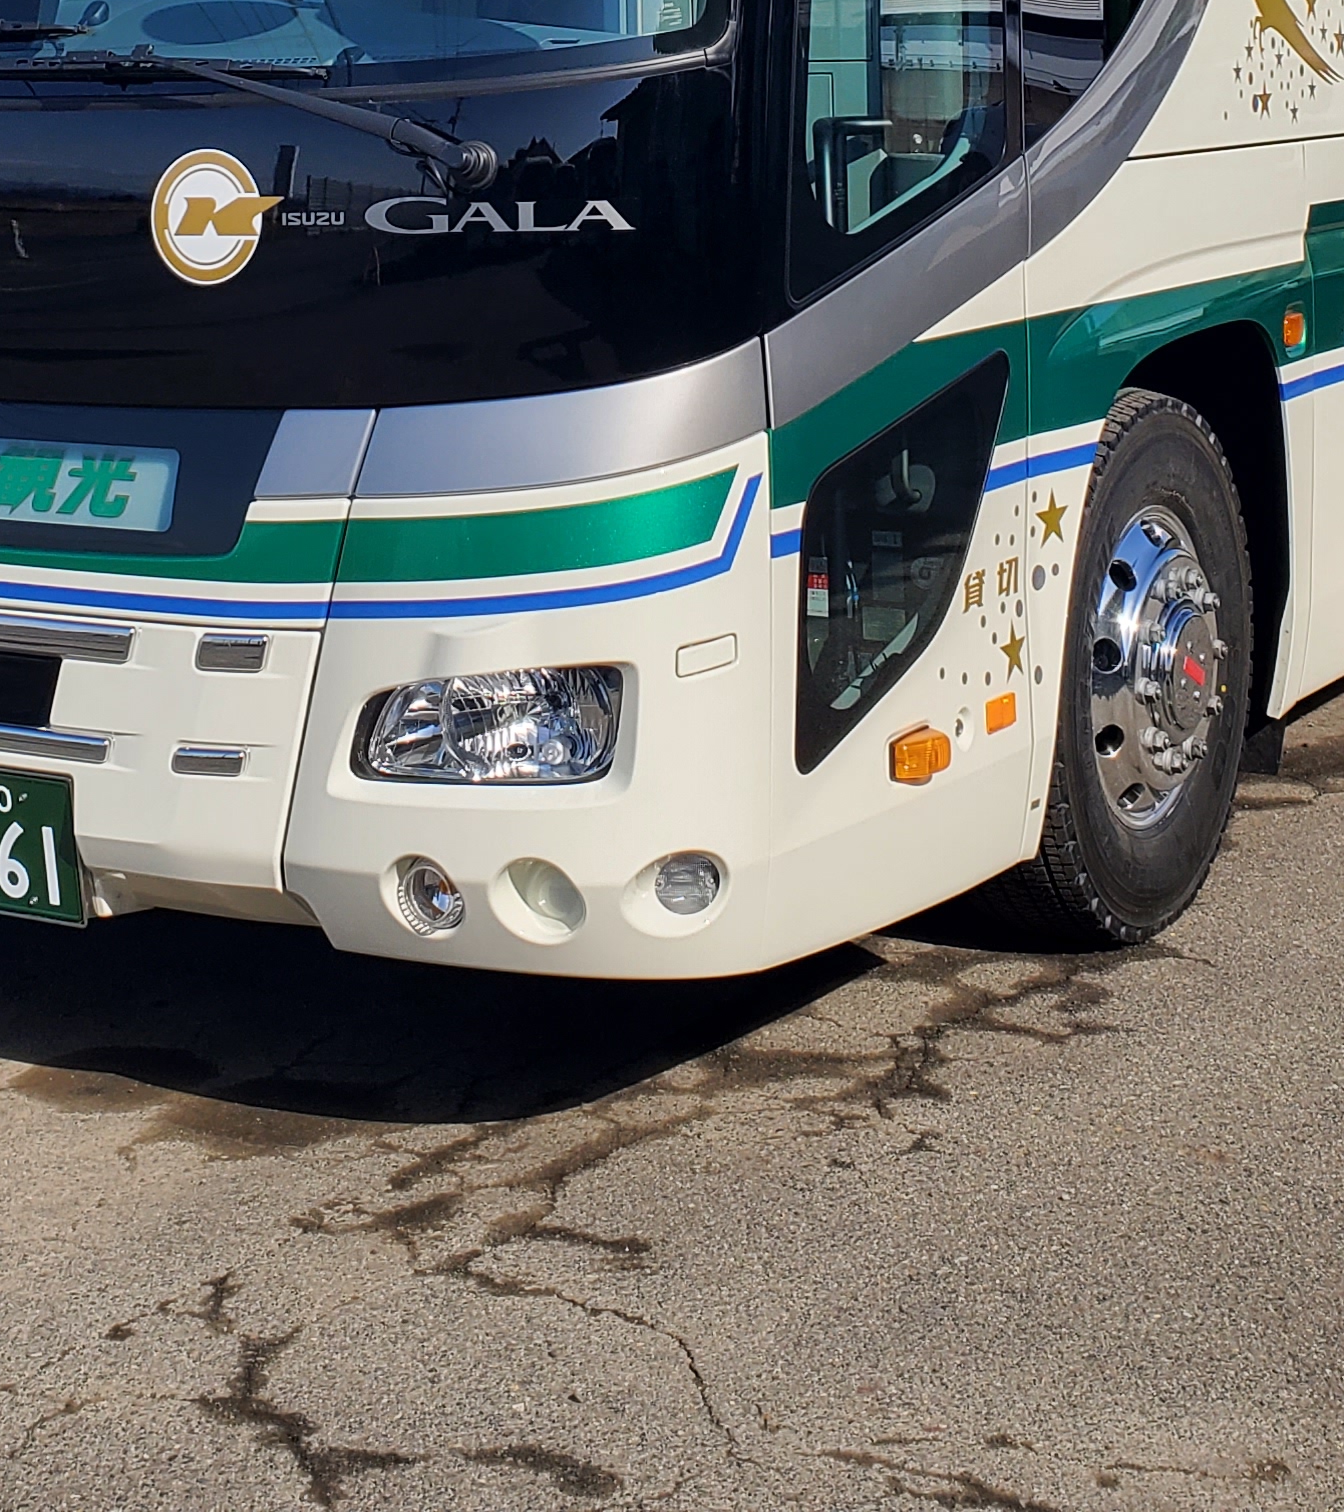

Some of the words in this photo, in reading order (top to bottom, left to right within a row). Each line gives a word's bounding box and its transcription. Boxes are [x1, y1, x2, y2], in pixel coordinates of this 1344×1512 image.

[281, 211, 346, 226] ISUZU
[364, 196, 637, 234] GALA
[962, 556, 1019, 614] 貸切
